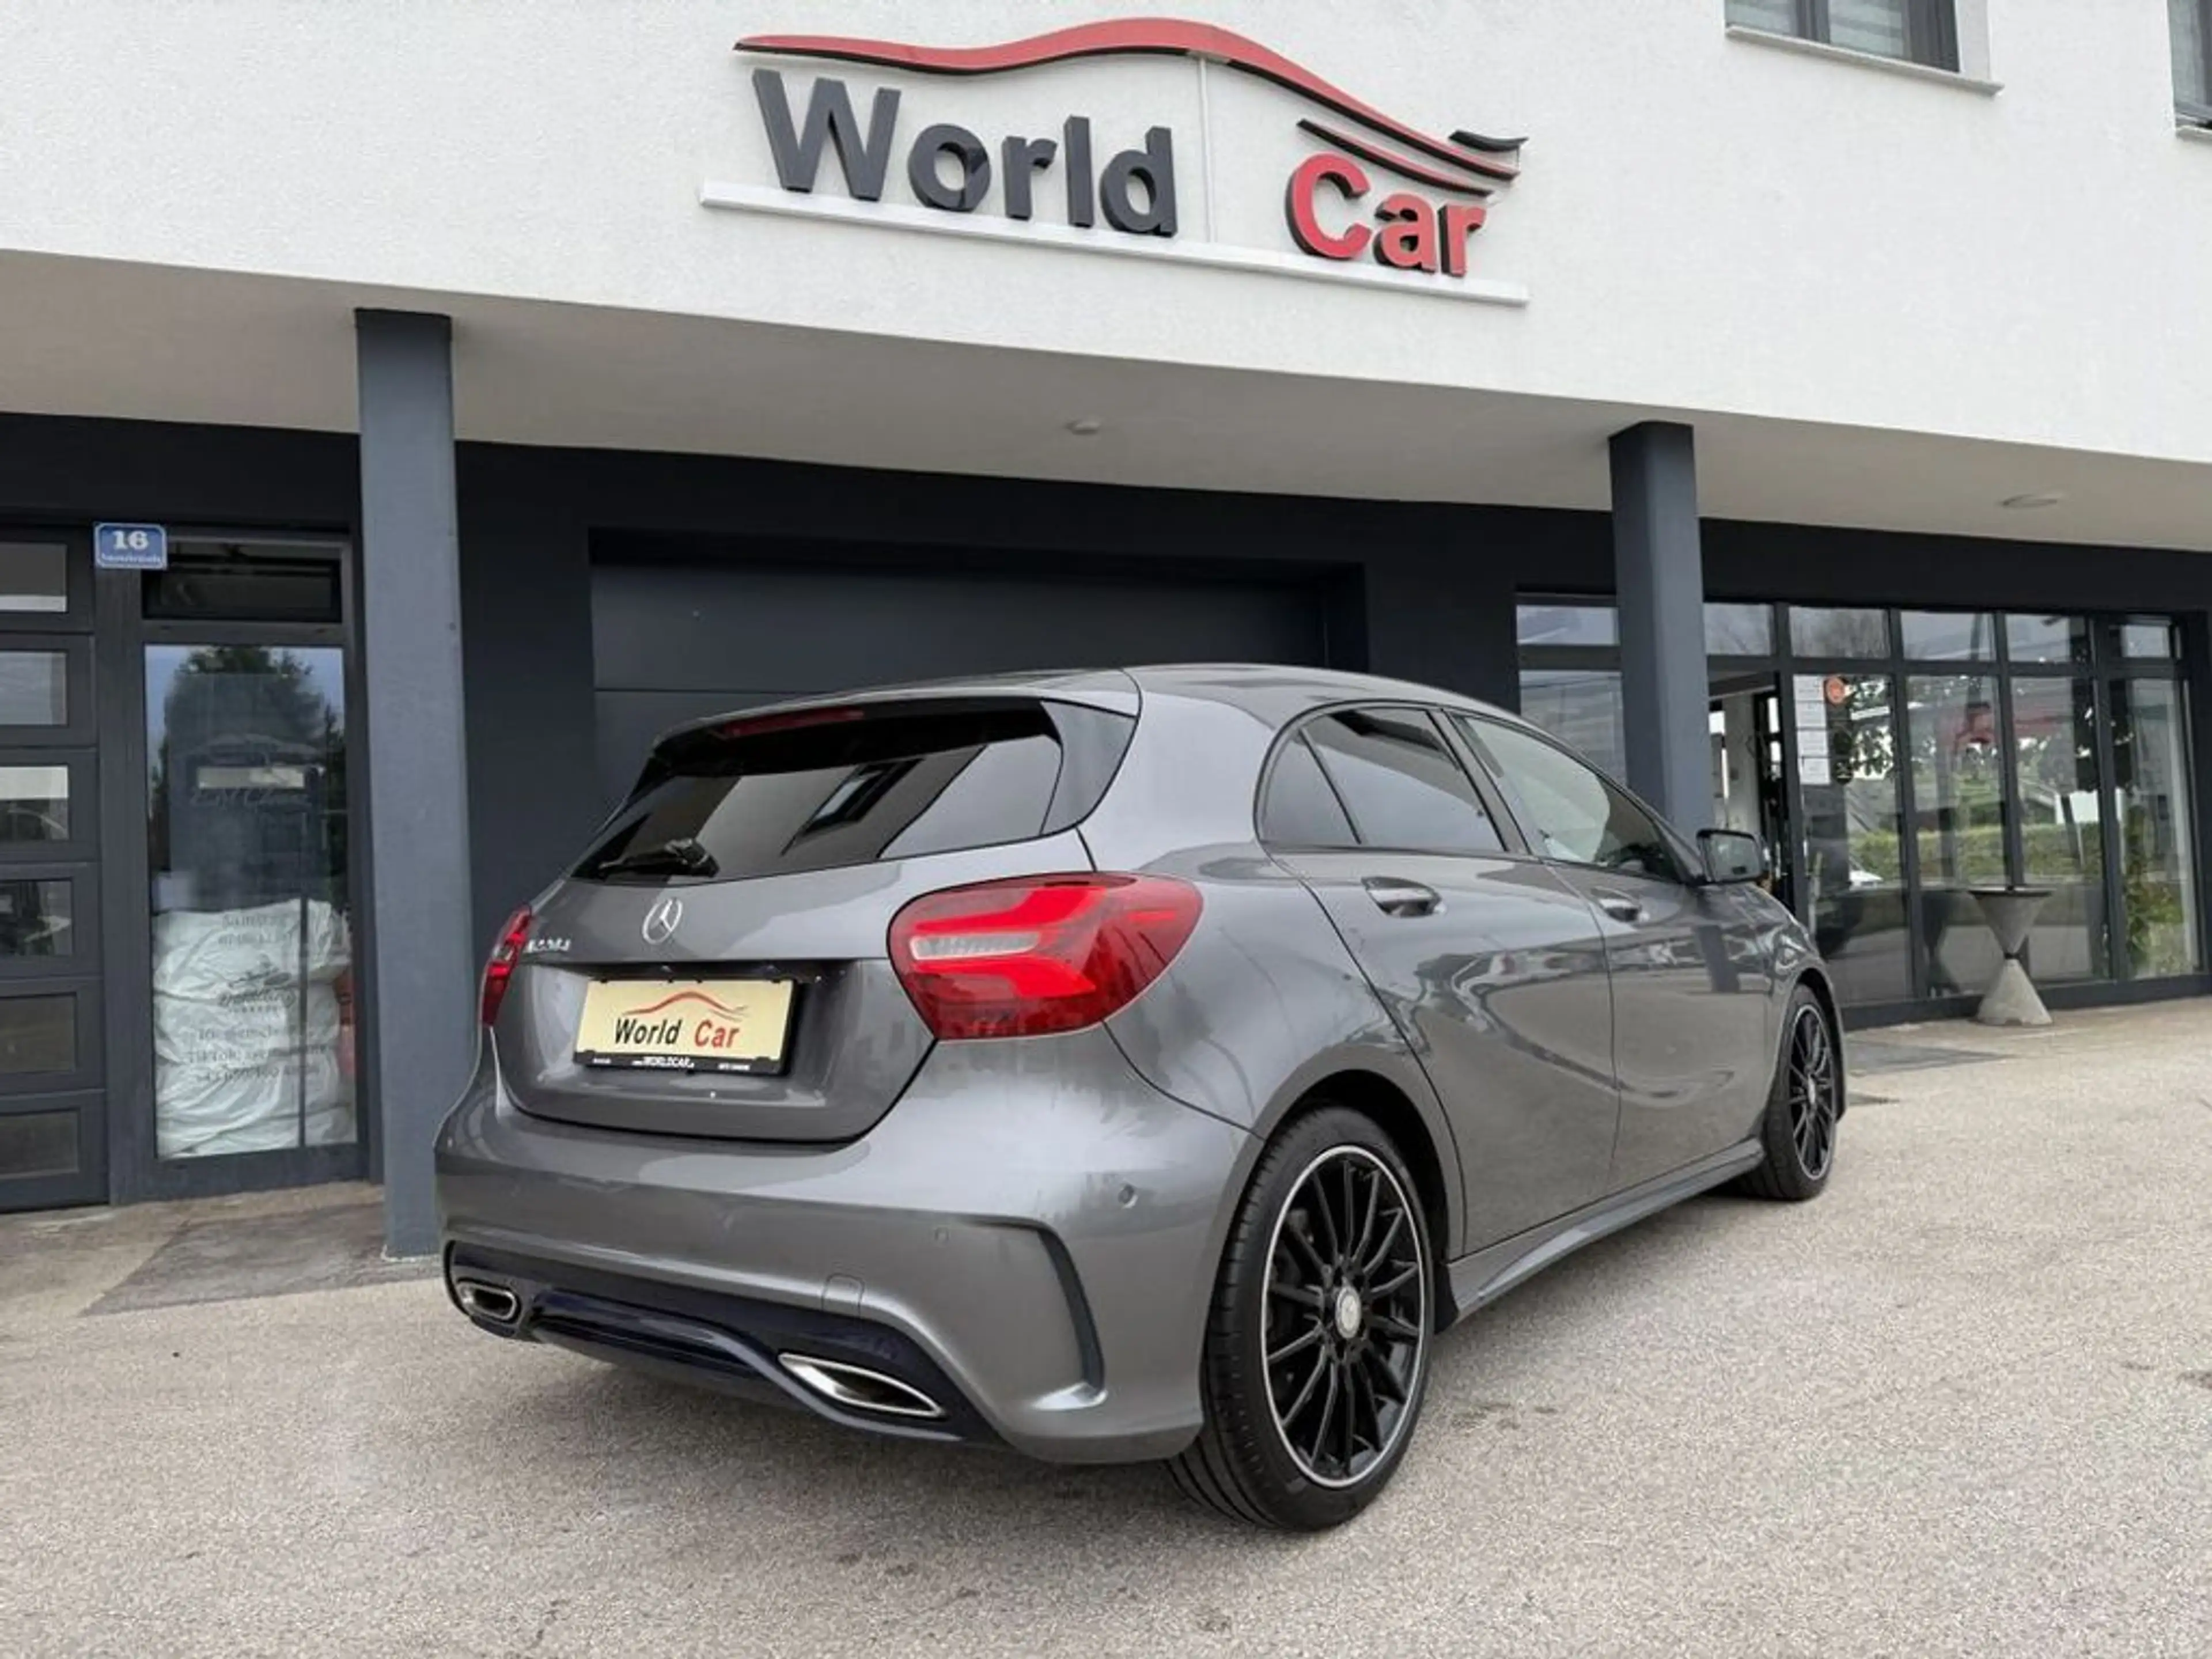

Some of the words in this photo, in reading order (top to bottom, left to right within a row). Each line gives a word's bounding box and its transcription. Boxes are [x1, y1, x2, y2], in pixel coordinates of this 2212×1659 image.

[752, 69, 1178, 238] World
[1285, 151, 1487, 278] Car
[112, 530, 149, 550] 16
[614, 1017, 683, 1045] World
[694, 1018, 740, 1048] Car
